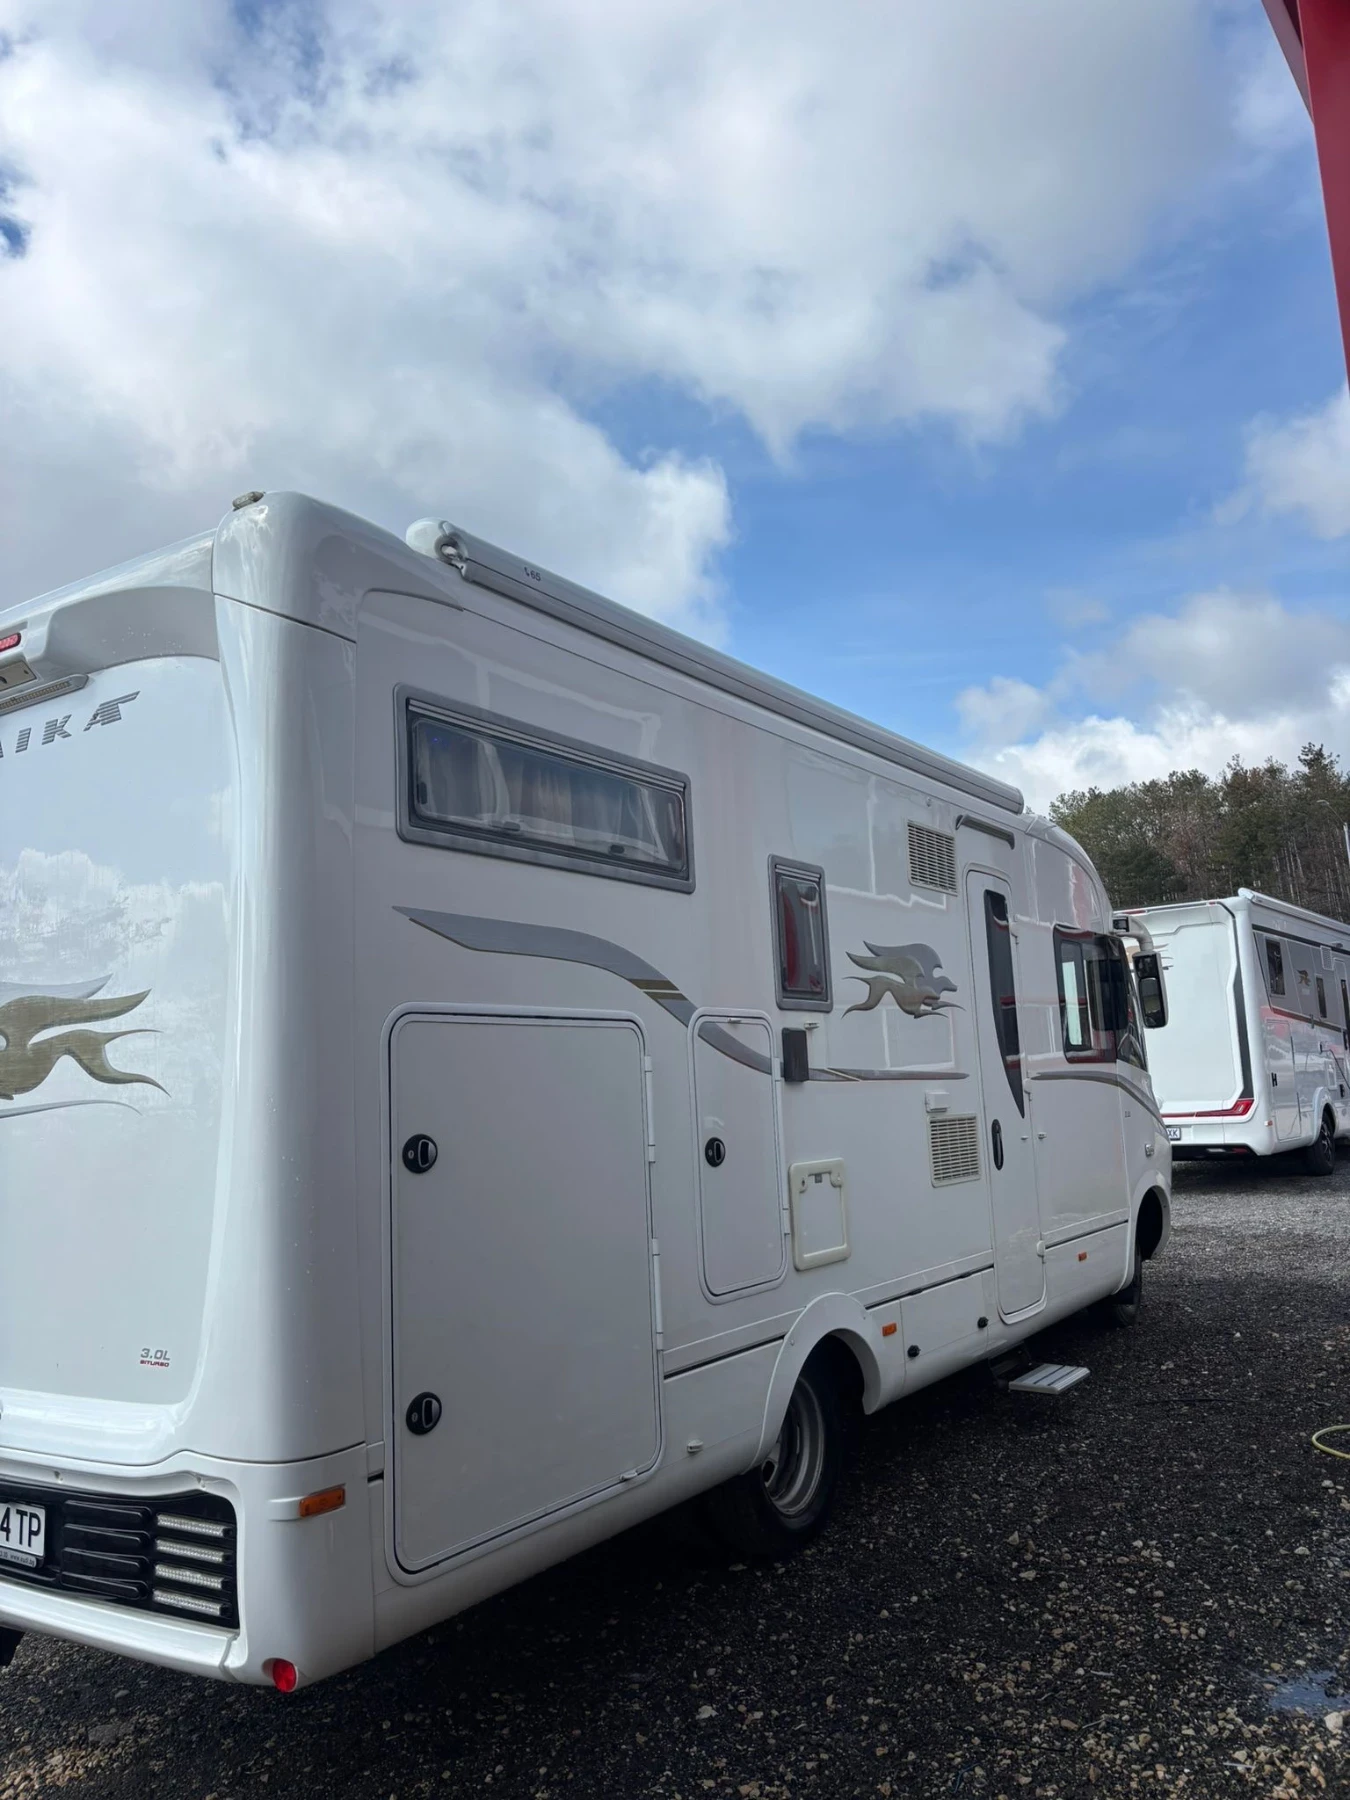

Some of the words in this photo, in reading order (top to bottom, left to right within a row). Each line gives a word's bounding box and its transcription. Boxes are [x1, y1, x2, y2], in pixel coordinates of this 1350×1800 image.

[140, 1347, 171, 1361] 3.0L
[139, 1359, 170, 1368] BITURBO
[16, 1508, 41, 1547] TP
